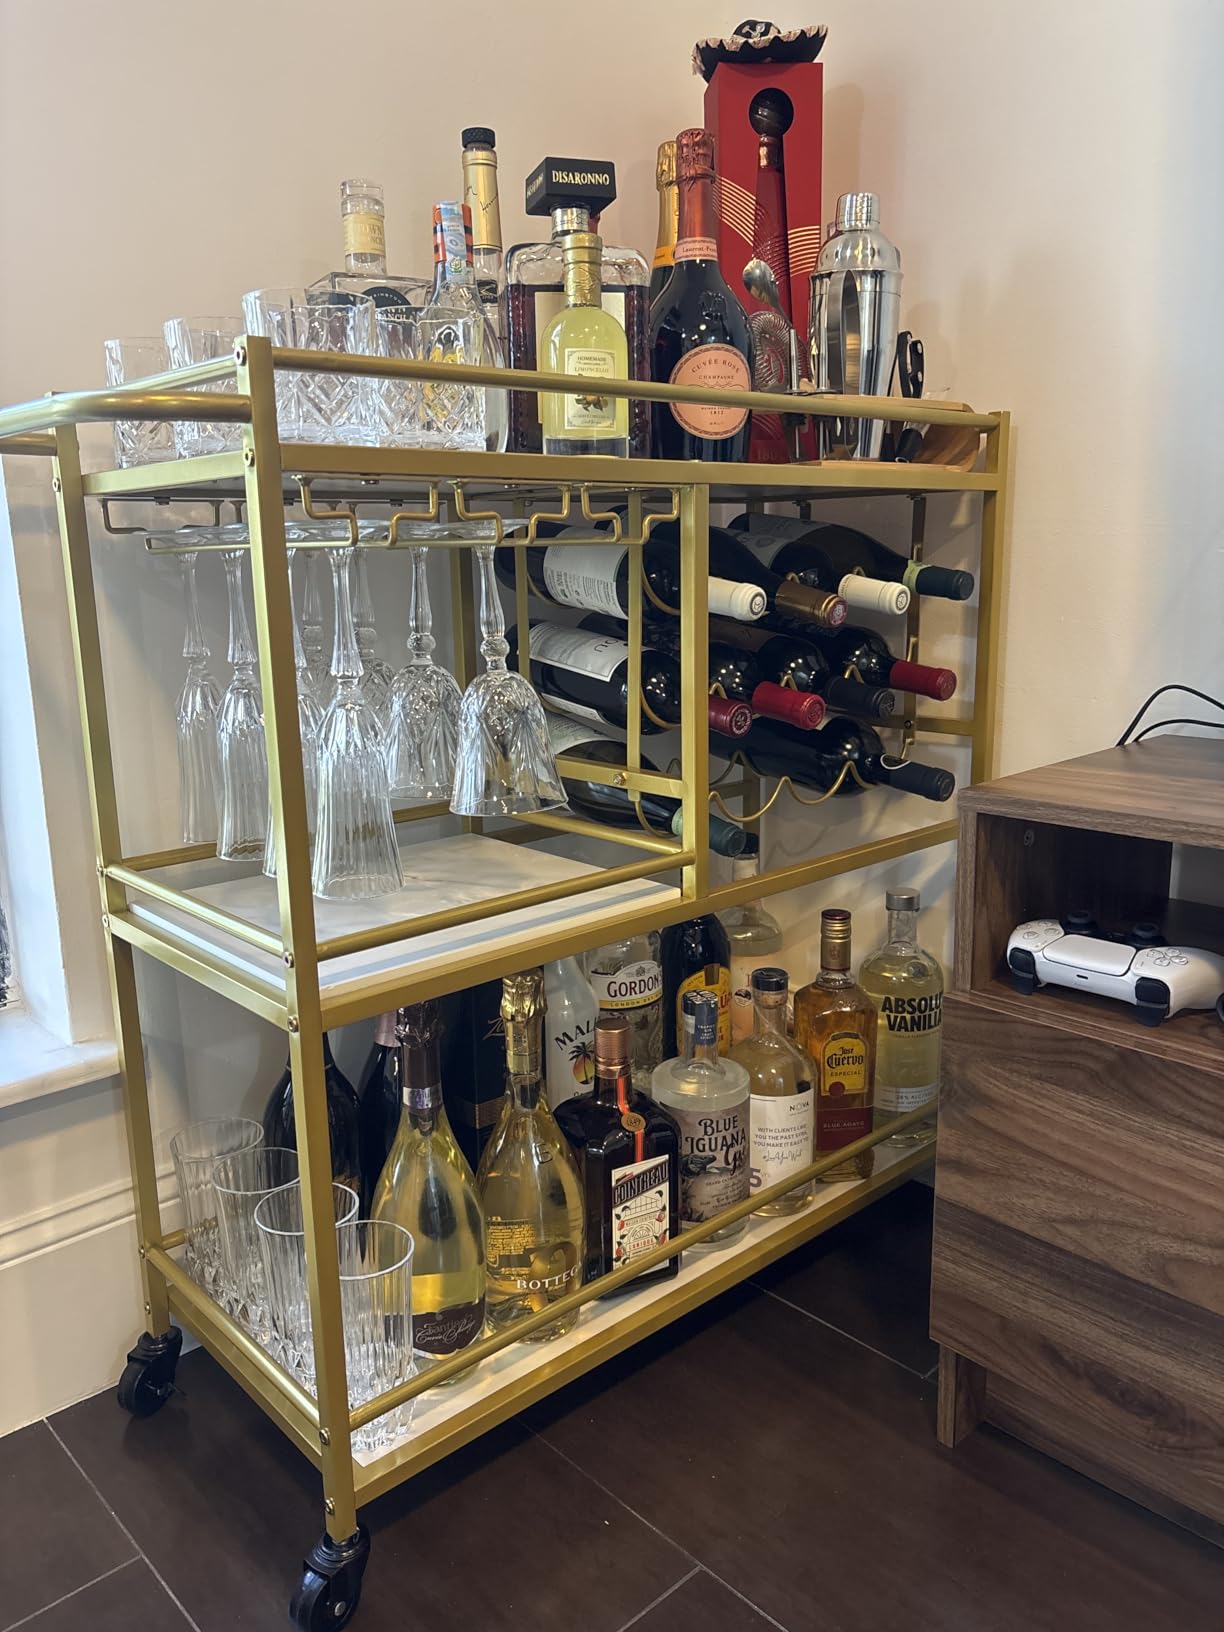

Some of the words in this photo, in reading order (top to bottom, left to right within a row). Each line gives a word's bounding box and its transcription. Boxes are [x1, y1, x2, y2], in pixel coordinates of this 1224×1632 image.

[552, 170, 610, 185] DISARONNO
[691, 358, 720, 373] CUVÉE
[826, 1053, 864, 1069] Cuervo
[698, 1115, 738, 1137] BLUE
[685, 1128, 747, 1155] IGUANA
[614, 1161, 669, 1204] COINTREAU
